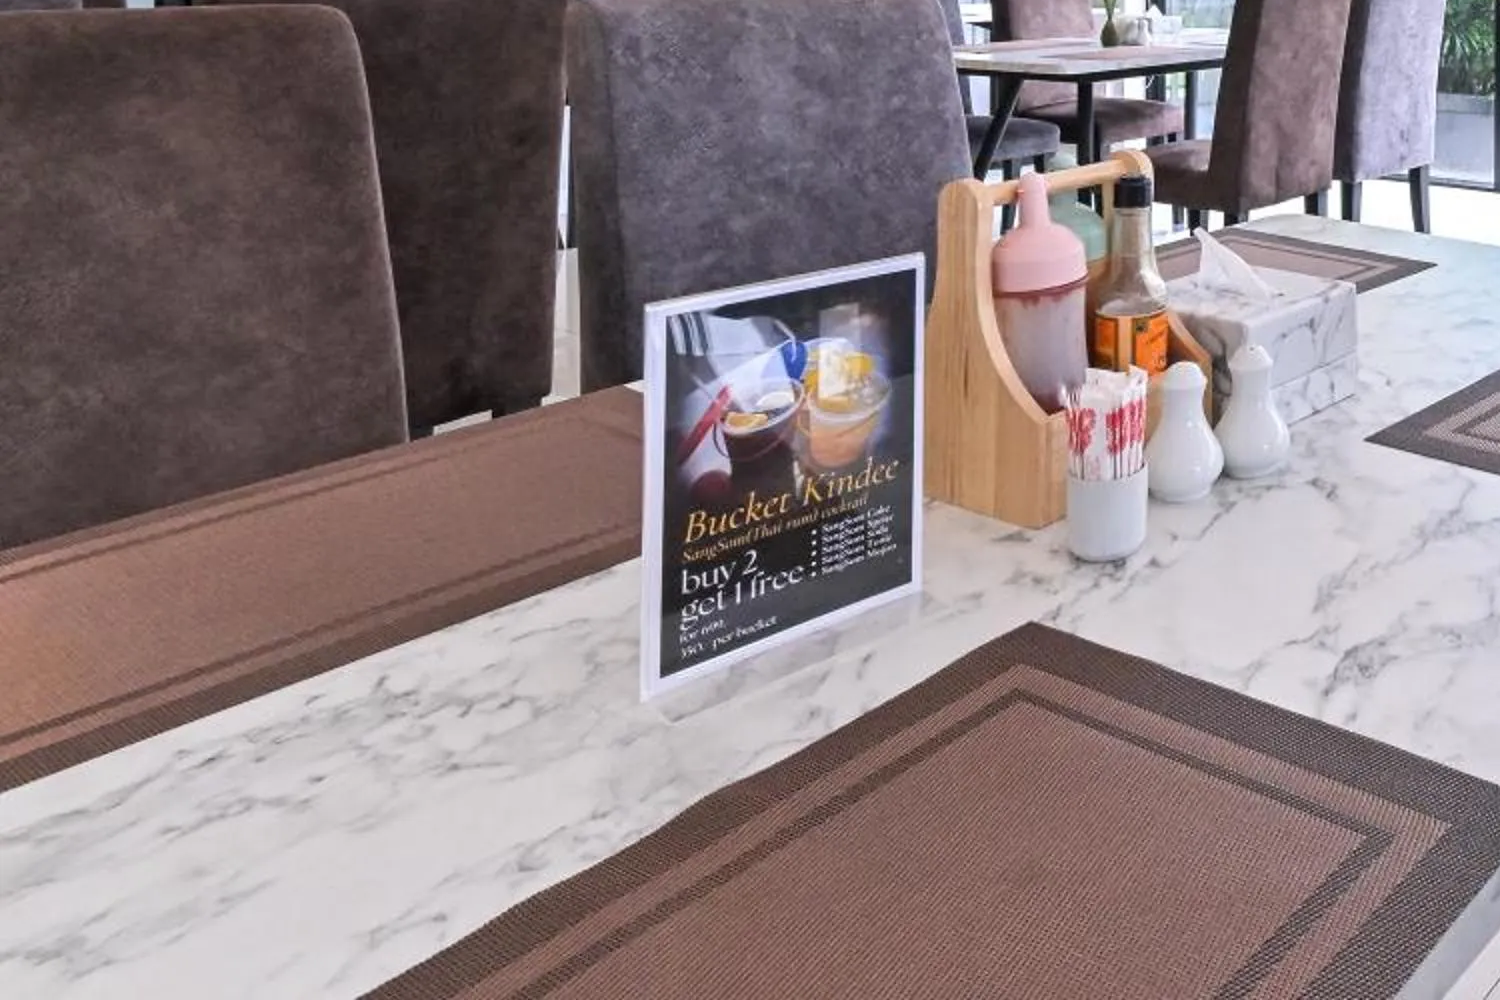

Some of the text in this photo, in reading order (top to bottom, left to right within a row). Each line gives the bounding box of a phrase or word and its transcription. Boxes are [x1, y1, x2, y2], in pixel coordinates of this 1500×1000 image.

[685, 455, 899, 543] Bucket Kindee
[680, 583, 727, 631] get
[751, 565, 805, 599] free
[681, 548, 759, 595] buy 2
